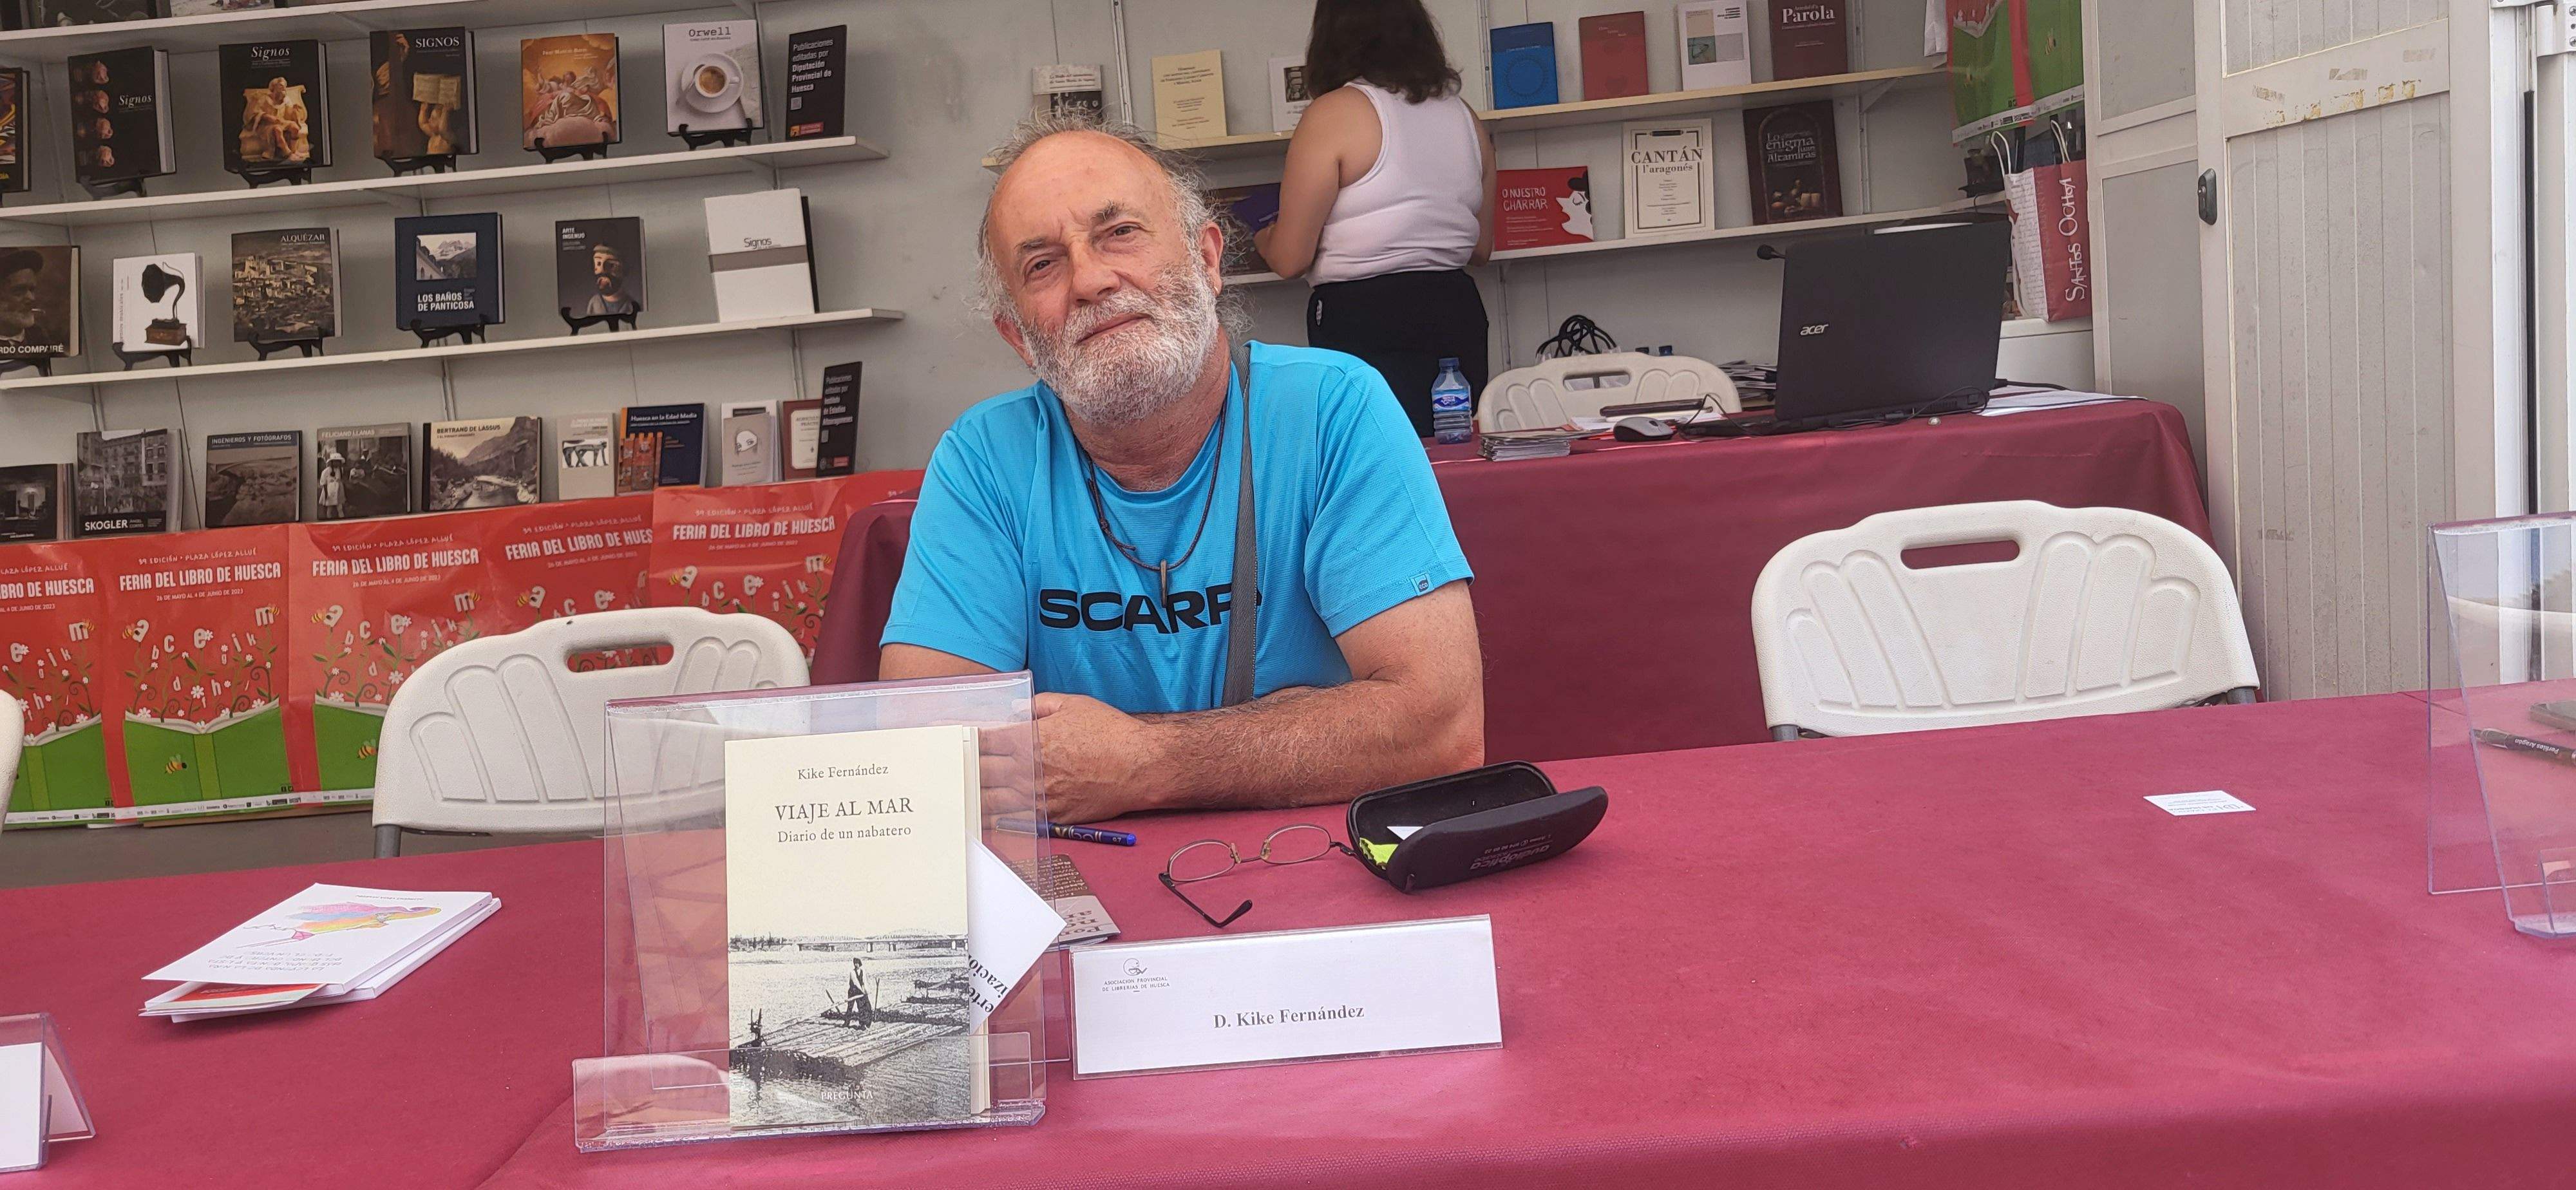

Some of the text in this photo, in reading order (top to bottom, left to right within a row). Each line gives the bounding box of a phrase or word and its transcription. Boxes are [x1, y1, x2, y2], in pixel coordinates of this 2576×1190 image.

[1782, 5, 1835, 23] Parola
[688, 27, 732, 37] Orwell
[415, 36, 460, 48] SIGNOS
[793, 39, 833, 52] Publicaciones
[251, 46, 290, 61] Signos
[793, 49, 829, 62] editadas por
[792, 61, 825, 72] Diputación
[792, 71, 823, 82] Provincial
[791, 83, 814, 93] Huesca
[118, 95, 152, 108] Signos
[1767, 133, 1780, 141] Lo
[1766, 137, 1814, 151] enigma
[1631, 146, 1703, 164] CANTÁN
[1768, 152, 1817, 163] Altamiras
[1643, 163, 1693, 175] l'aragonés
[1502, 187, 1546, 198] O NUESTRO
[1503, 198, 1548, 211] CHARRAR
[281, 232, 325, 243] ALQUÉZAR
[744, 238, 772, 250] Signos
[2058, 177, 2086, 302] SANTOS OCHOA
[418, 291, 462, 303] LOS BAÑOS
[418, 301, 475, 312] DE PANTICOSA
[1800, 322, 1829, 335] acer
[437, 426, 468, 434] BERTRAND
[211, 435, 245, 445] INGENIEROS
[253, 434, 292, 442] FOTÓGRAFOS
[84, 519, 128, 531] SKOGLER
[673, 515, 835, 540] FERIA DEL LIBRO DE HUESCA
[343, 543, 372, 552] EDICIÓN
[379, 540, 404, 548] PLAZA
[406, 538, 428, 546] LÓPEZ
[431, 533, 453, 543] ALLUÉ
[506, 541, 541, 561] FERIA
[542, 538, 565, 556] DEL
[567, 533, 603, 552] LIBRO
[605, 531, 623, 547] DE
[623, 528, 653, 545] HUES
[149, 555, 178, 564] EDICIÓN
[185, 551, 209, 561] PLAZA
[211, 550, 233, 559] LÓPEZ
[235, 547, 256, 556] ALLUÉ
[312, 548, 480, 576] FERIA DEL LIBRO DE HUESCA
[45, 563, 68, 572] ALLUÉ
[120, 562, 281, 591] FERIA DEL LIBRO DE HUESCA
[0, 578, 94, 599] BRO DE HUESCA
[1039, 583, 1261, 634] SCARP
[2514, 738, 2537, 749] Aragón
[797, 763, 889, 780] Kike Fernández
[775, 797, 914, 824] VIAJE AL MAR
[777, 824, 911, 844] Diario de un nabatero
[968, 955, 1009, 998] izació
[1213, 1005, 1365, 1029] D. Kike Fernández
[820, 1089, 874, 1101] PREGUNTA
